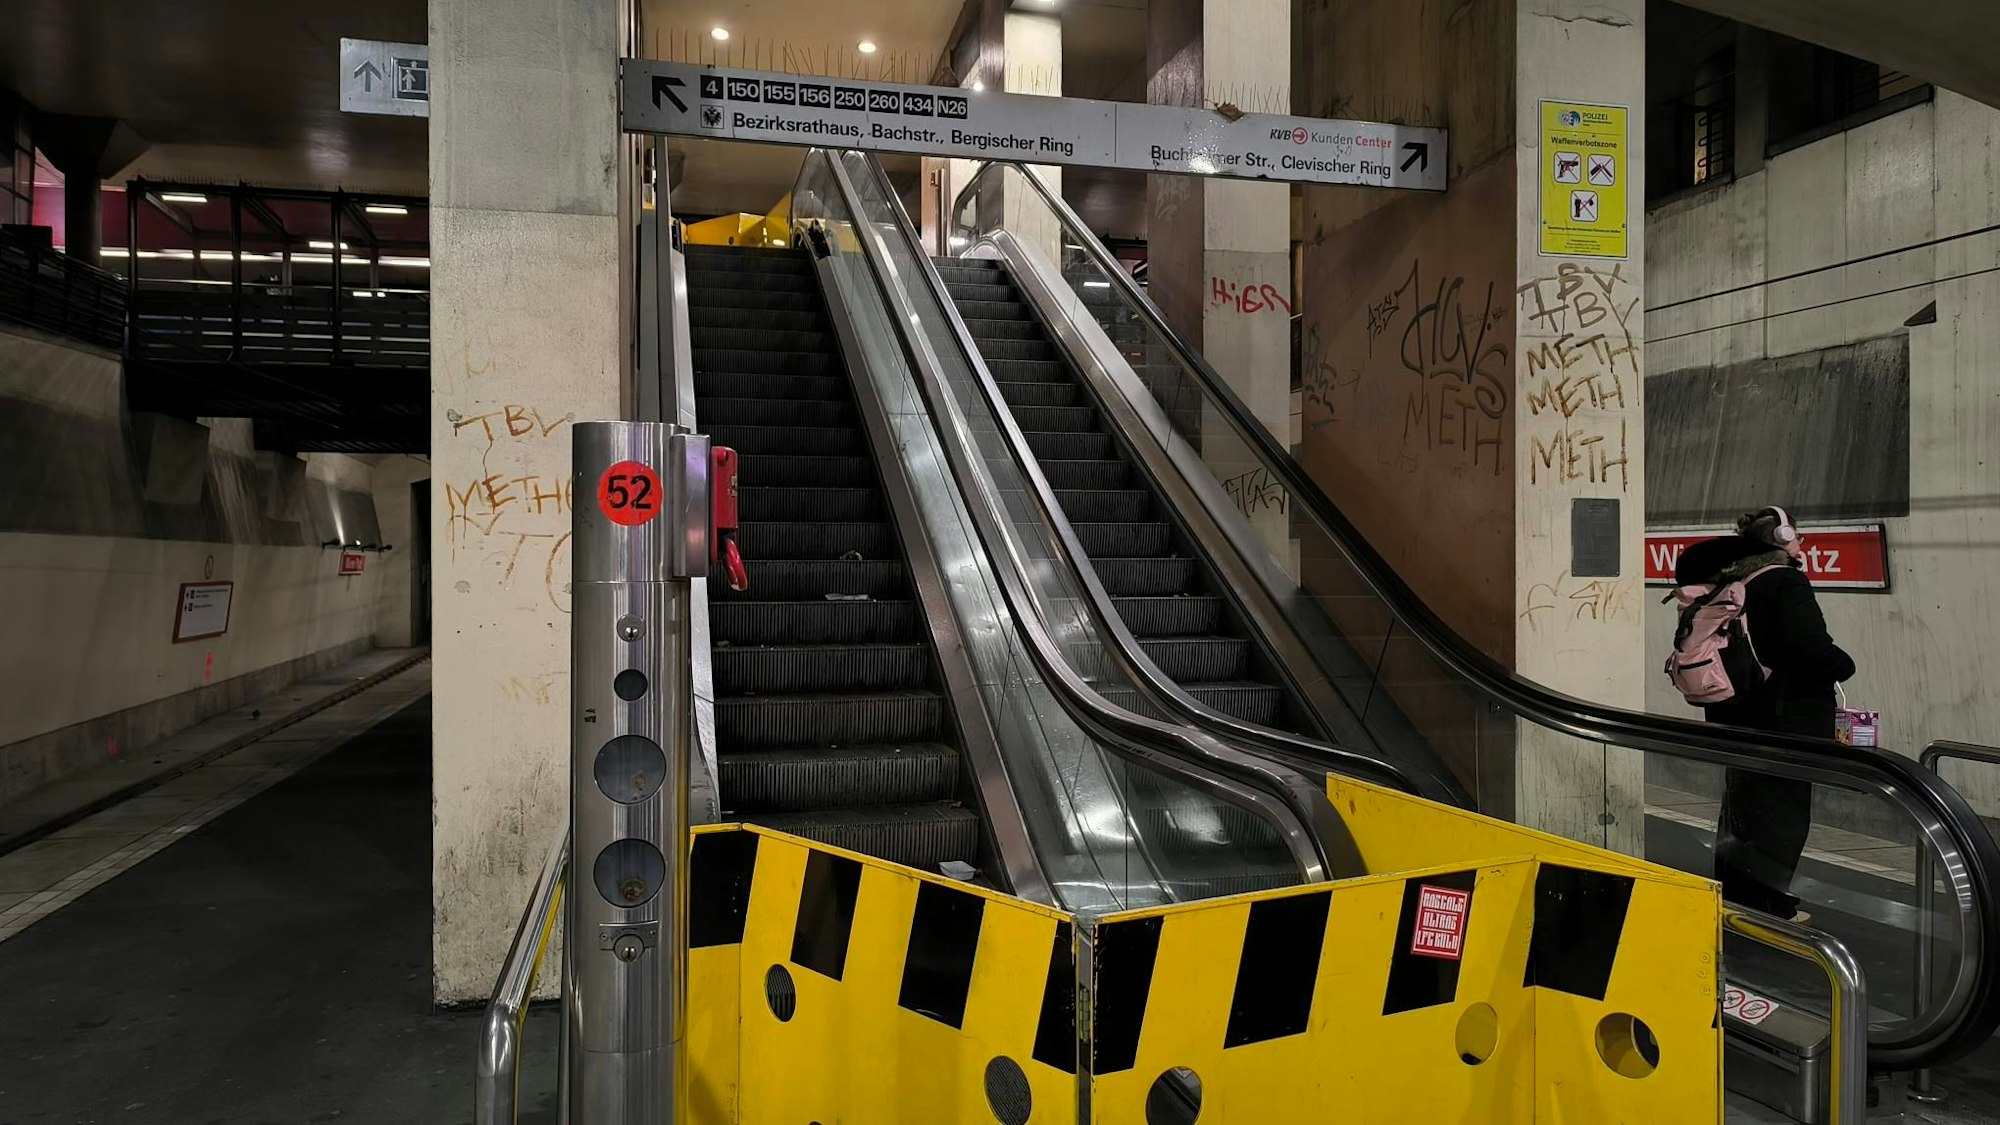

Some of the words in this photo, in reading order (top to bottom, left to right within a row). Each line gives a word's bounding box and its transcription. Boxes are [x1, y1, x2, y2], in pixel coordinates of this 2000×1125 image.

[706, 80, 718, 95] 4
[728, 82, 760, 98] 150
[764, 85, 795, 101] 155
[800, 88, 830, 104] 156
[835, 91, 865, 107] 250
[869, 94, 899, 110] 260
[904, 97, 933, 113] 434
[938, 100, 967, 115] N26
[733, 112, 864, 138] Bezirksrathaus,
[872, 123, 944, 144] Bachstr.,
[951, 130, 1035, 151] Bergischer
[1040, 136, 1074, 156] Ring
[1582, 112, 1608, 121] POLIZEI
[1270, 129, 1292, 141] KVB
[1311, 132, 1353, 145] Kunden
[1355, 135, 1392, 149] Center
[1551, 136, 1618, 149] Waffenverbotszone
[1245, 152, 1276, 172] Str.,
[1281, 155, 1356, 174] Clevischer
[1360, 160, 1391, 179] Ring
[1527, 332, 1640, 378] METH
[1526, 373, 1625, 417] METH
[1531, 417, 1628, 493] METH
[607, 474, 652, 510] 52
[1422, 911, 1457, 930] ULTRAS
